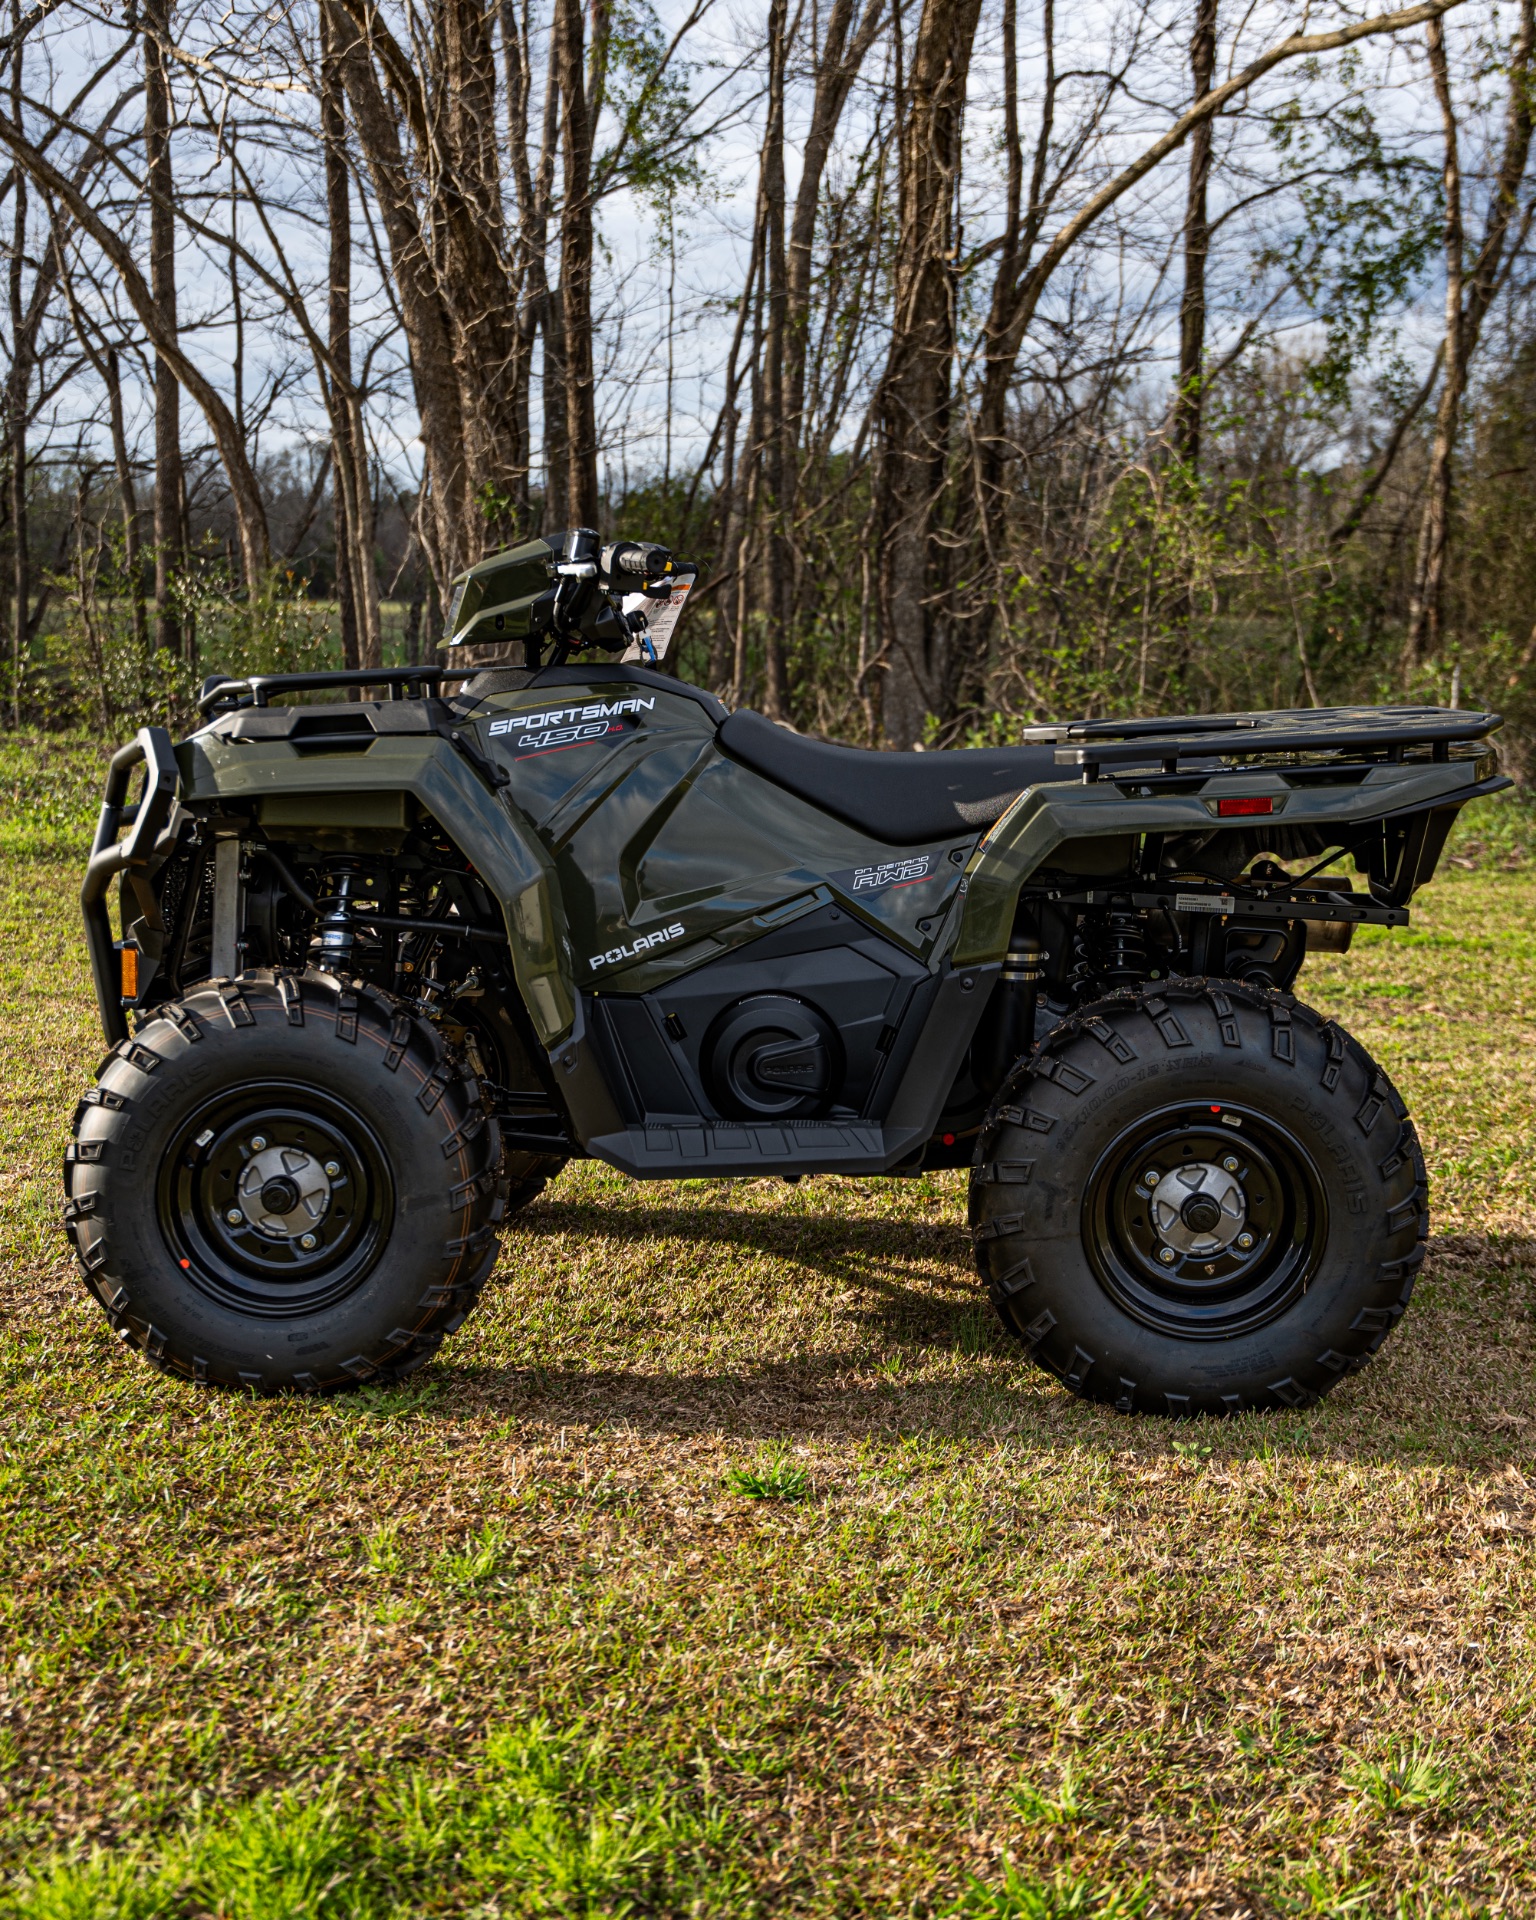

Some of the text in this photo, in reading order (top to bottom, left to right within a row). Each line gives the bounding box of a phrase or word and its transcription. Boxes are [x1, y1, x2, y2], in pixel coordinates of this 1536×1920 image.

[488, 695, 656, 737] SPORTSMAN
[518, 720, 610, 748] 450
[852, 862, 929, 890] AWD
[854, 855, 930, 875] ON DEMAND
[588, 922, 685, 971] POLARIS
[762, 1064, 814, 1076] POLARIS
[118, 1061, 212, 1172] POLARIS
[1290, 1096, 1368, 1214] POLARIS
